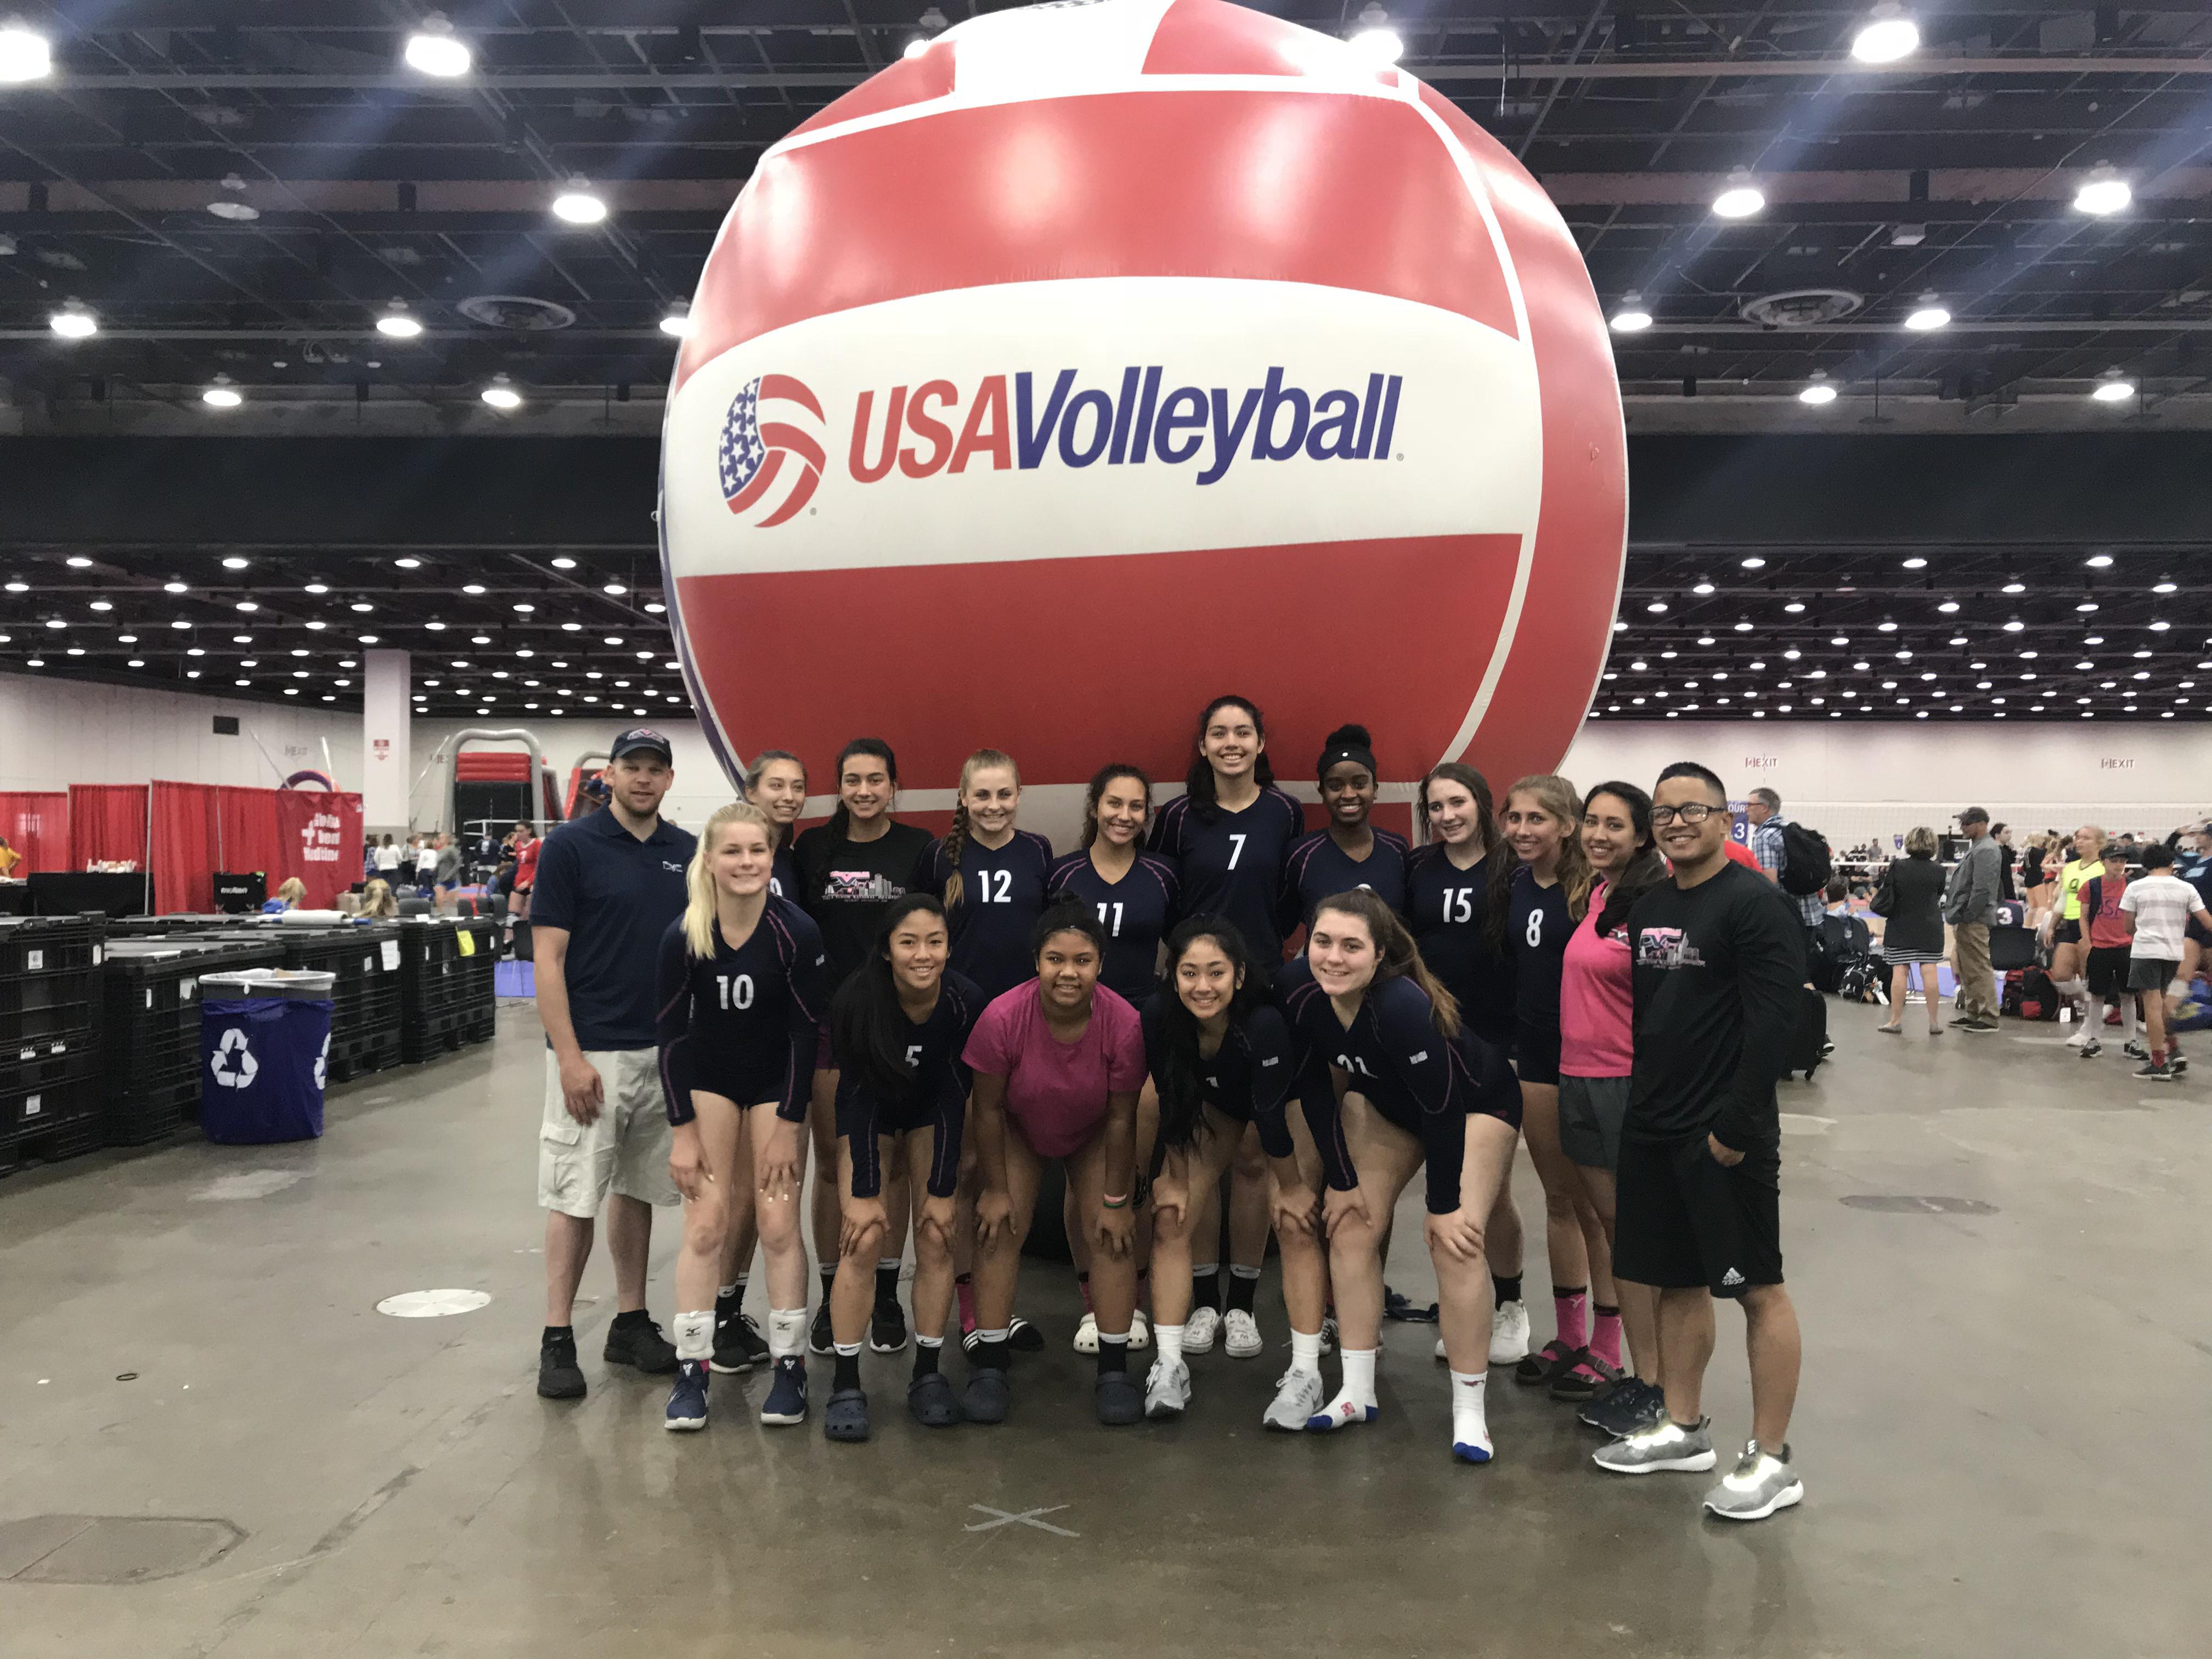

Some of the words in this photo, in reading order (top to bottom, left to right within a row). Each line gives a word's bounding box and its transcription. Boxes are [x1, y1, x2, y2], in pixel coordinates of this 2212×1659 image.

[1756, 758, 1778, 767] EXIT
[2112, 759, 2134, 769] EXIT
[1728, 804, 1748, 813] OUR
[1734, 822, 1745, 839] 3
[1227, 833, 1247, 871] 7
[978, 868, 1012, 903] 12
[1097, 902, 1124, 937] 11
[1443, 887, 1473, 923] 15
[1526, 908, 1544, 947] 8
[716, 974, 754, 1010] 10
[905, 1045, 923, 1068] 5
